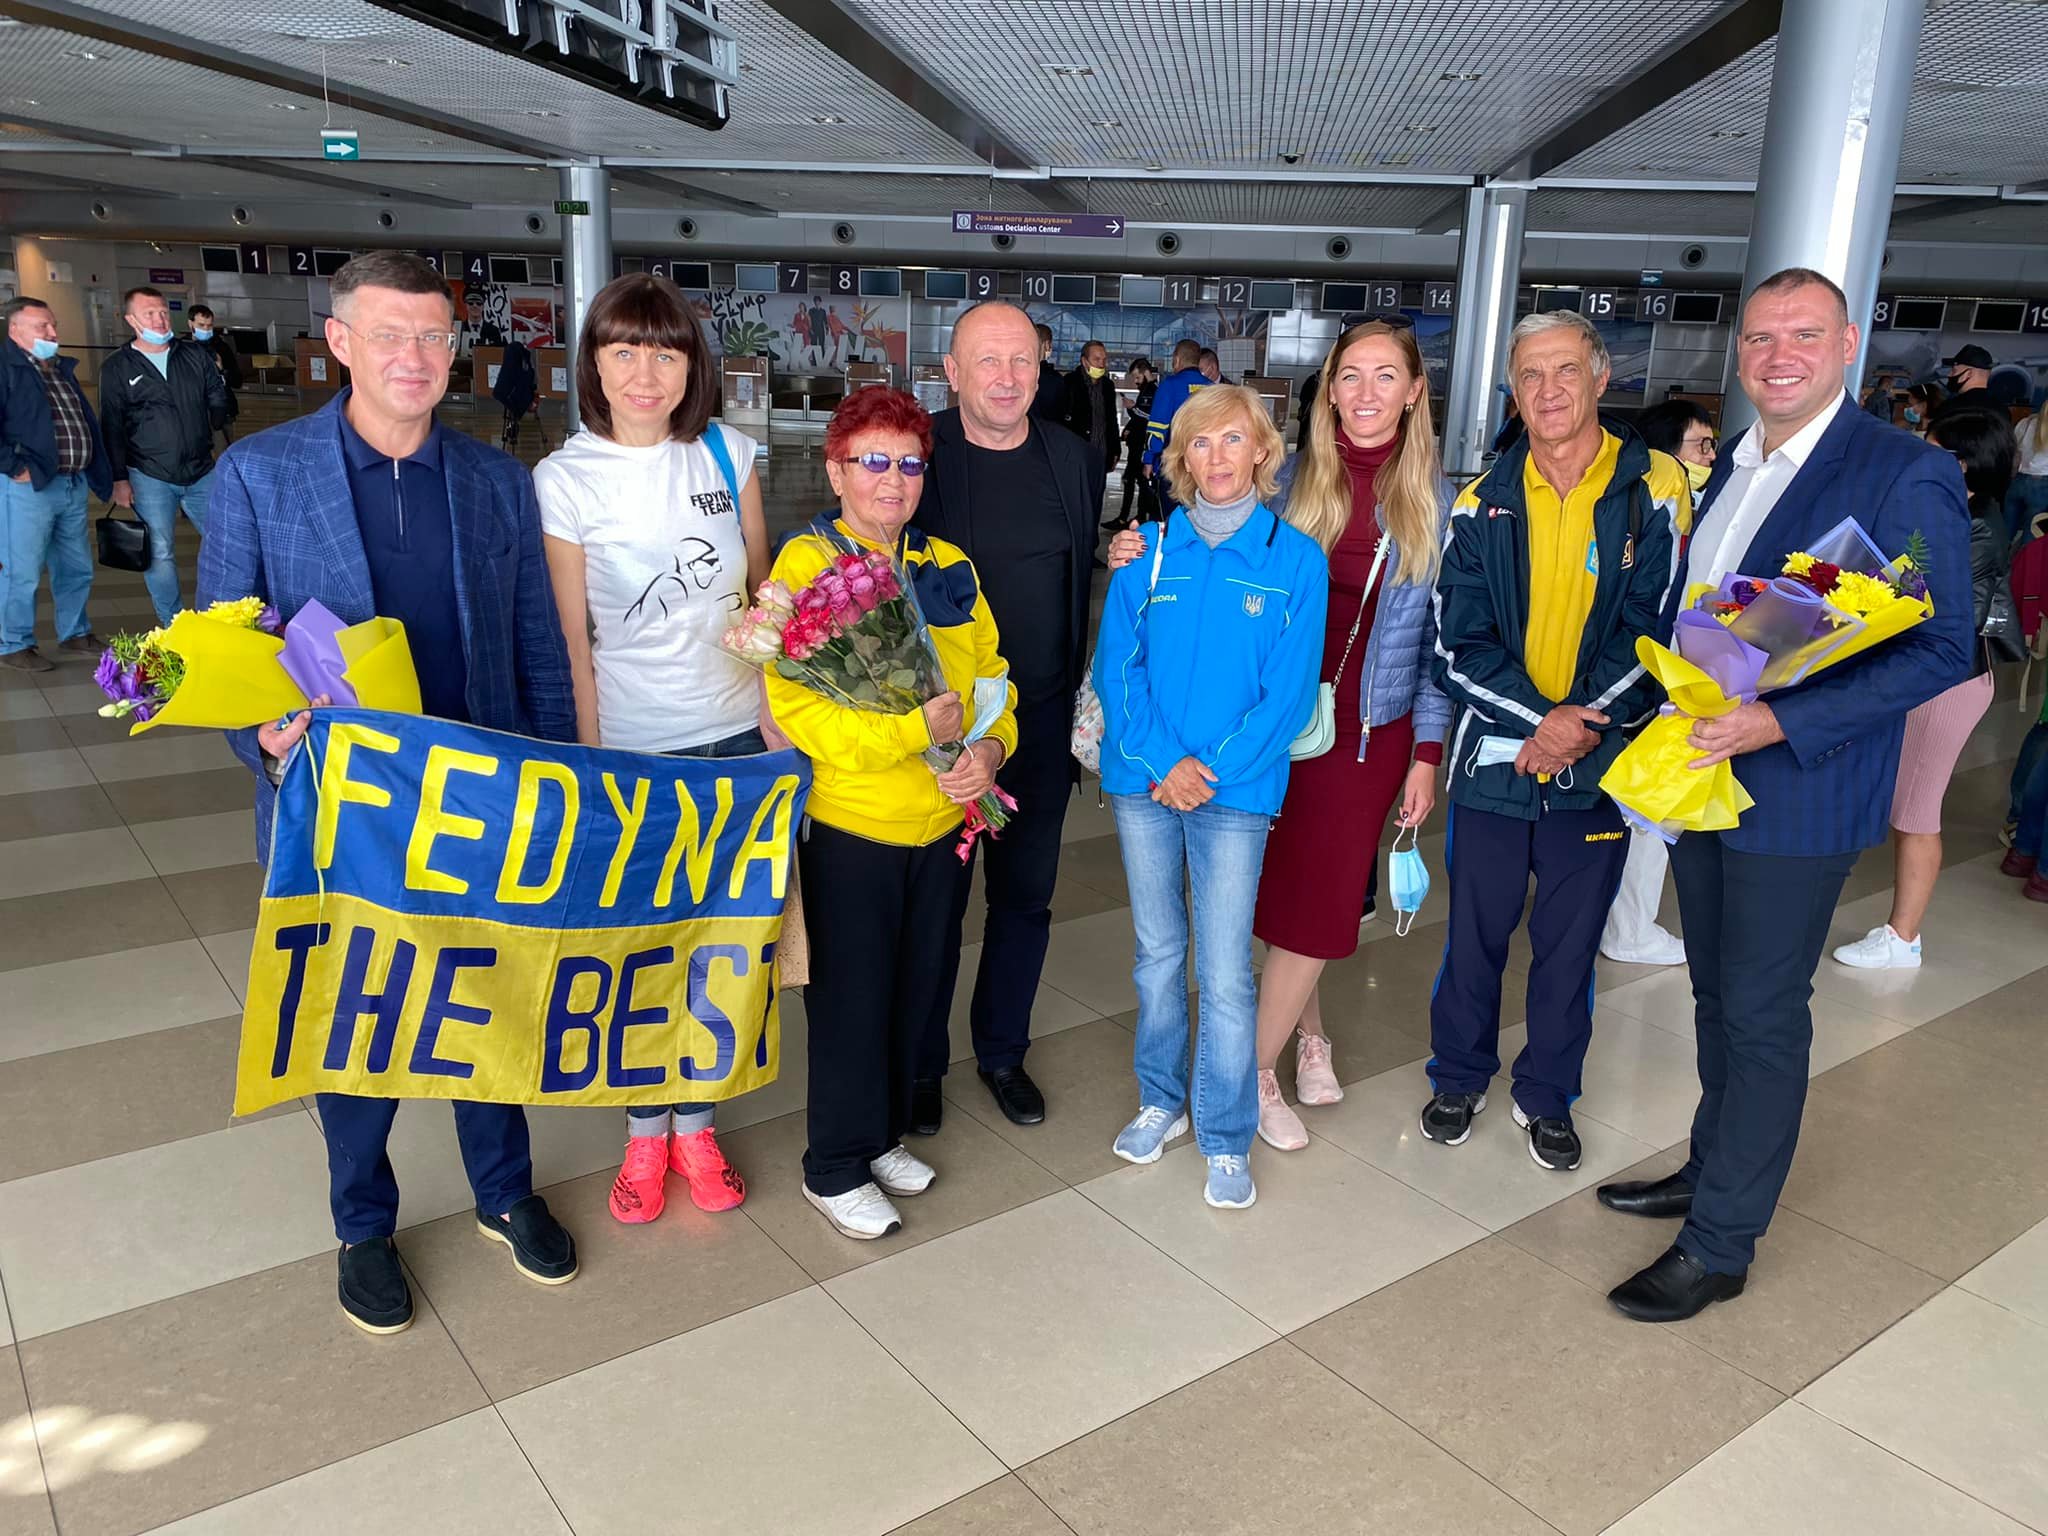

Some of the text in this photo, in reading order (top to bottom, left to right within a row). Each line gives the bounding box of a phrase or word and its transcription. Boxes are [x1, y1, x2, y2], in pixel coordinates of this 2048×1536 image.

[975, 223, 1061, 233] Customs Declation Center
[251, 251, 259, 268] 1
[296, 252, 308, 270] 2
[471, 258, 483, 277] 4
[788, 269, 800, 287] 7
[838, 271, 851, 290] 8
[978, 276, 991, 295] 9
[1025, 277, 1047, 297] 10
[1170, 281, 1190, 301] 11
[1223, 282, 1245, 303] 12
[1374, 287, 1396, 308] 13
[1429, 288, 1452, 309] 14
[1588, 292, 1611, 314] 15
[1643, 295, 1666, 316] 16
[1874, 301, 1889, 322] 8
[690, 489, 733, 507] FEDYNA
[699, 501, 734, 517] TEAM
[316, 722, 799, 908] FEDYNA
[270, 922, 497, 1079] THE
